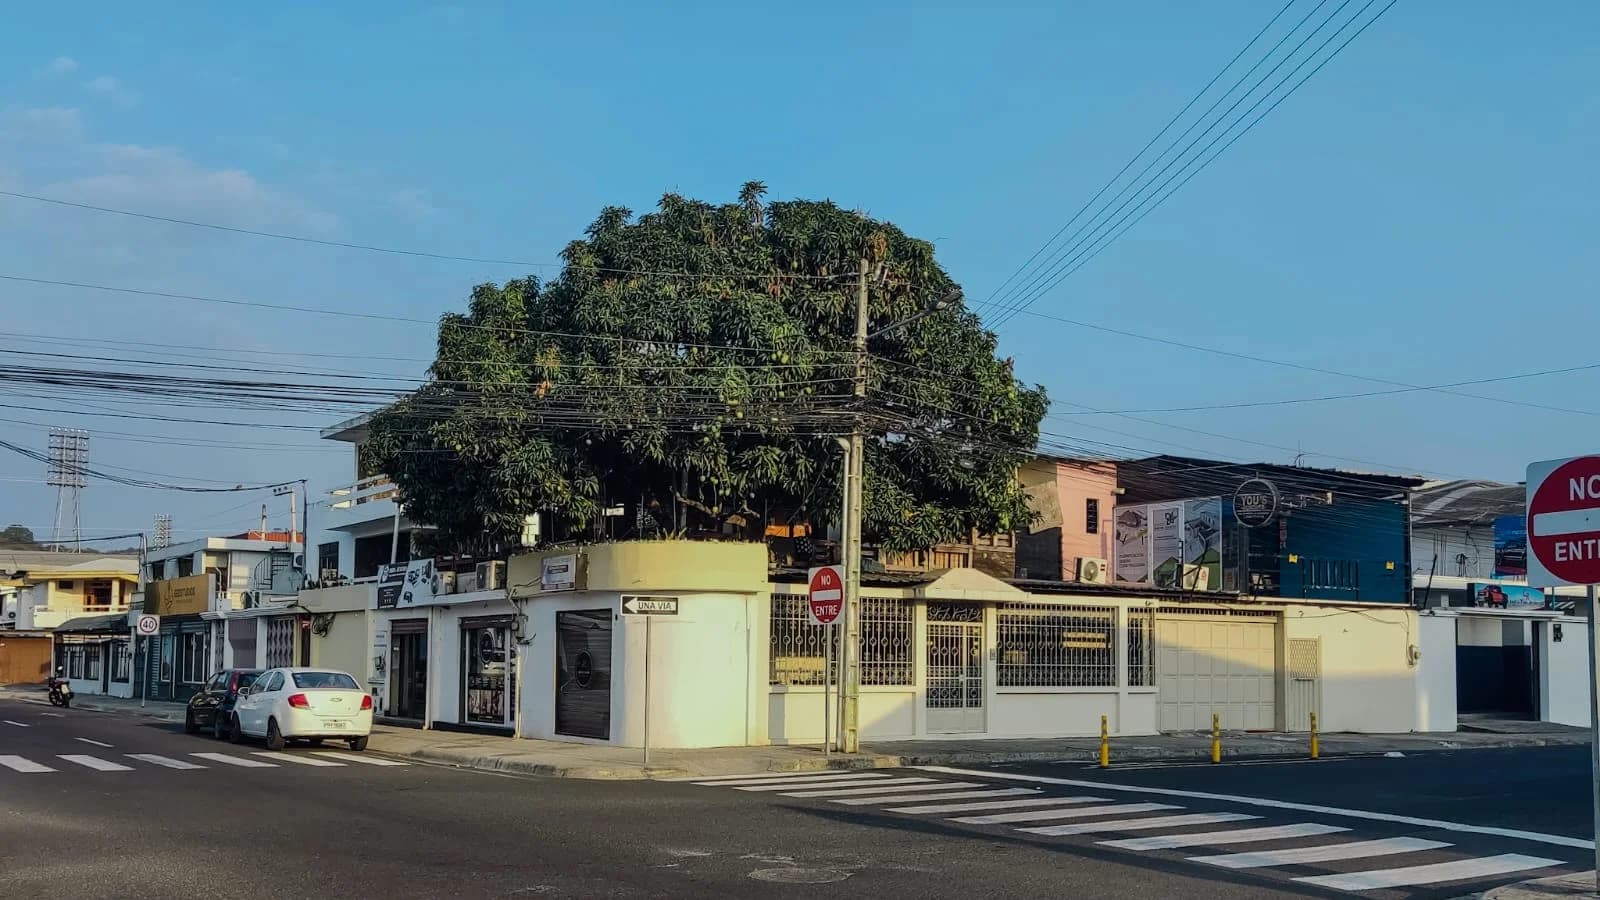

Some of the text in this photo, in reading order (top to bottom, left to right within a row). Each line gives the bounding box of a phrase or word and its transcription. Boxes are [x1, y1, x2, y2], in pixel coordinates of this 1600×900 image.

[1569, 475, 1600, 501] NO
[820, 575, 831, 586] NO
[638, 602, 673, 610] UNA VIA
[815, 605, 838, 617] ENTRE
[143, 620, 154, 630] 40
